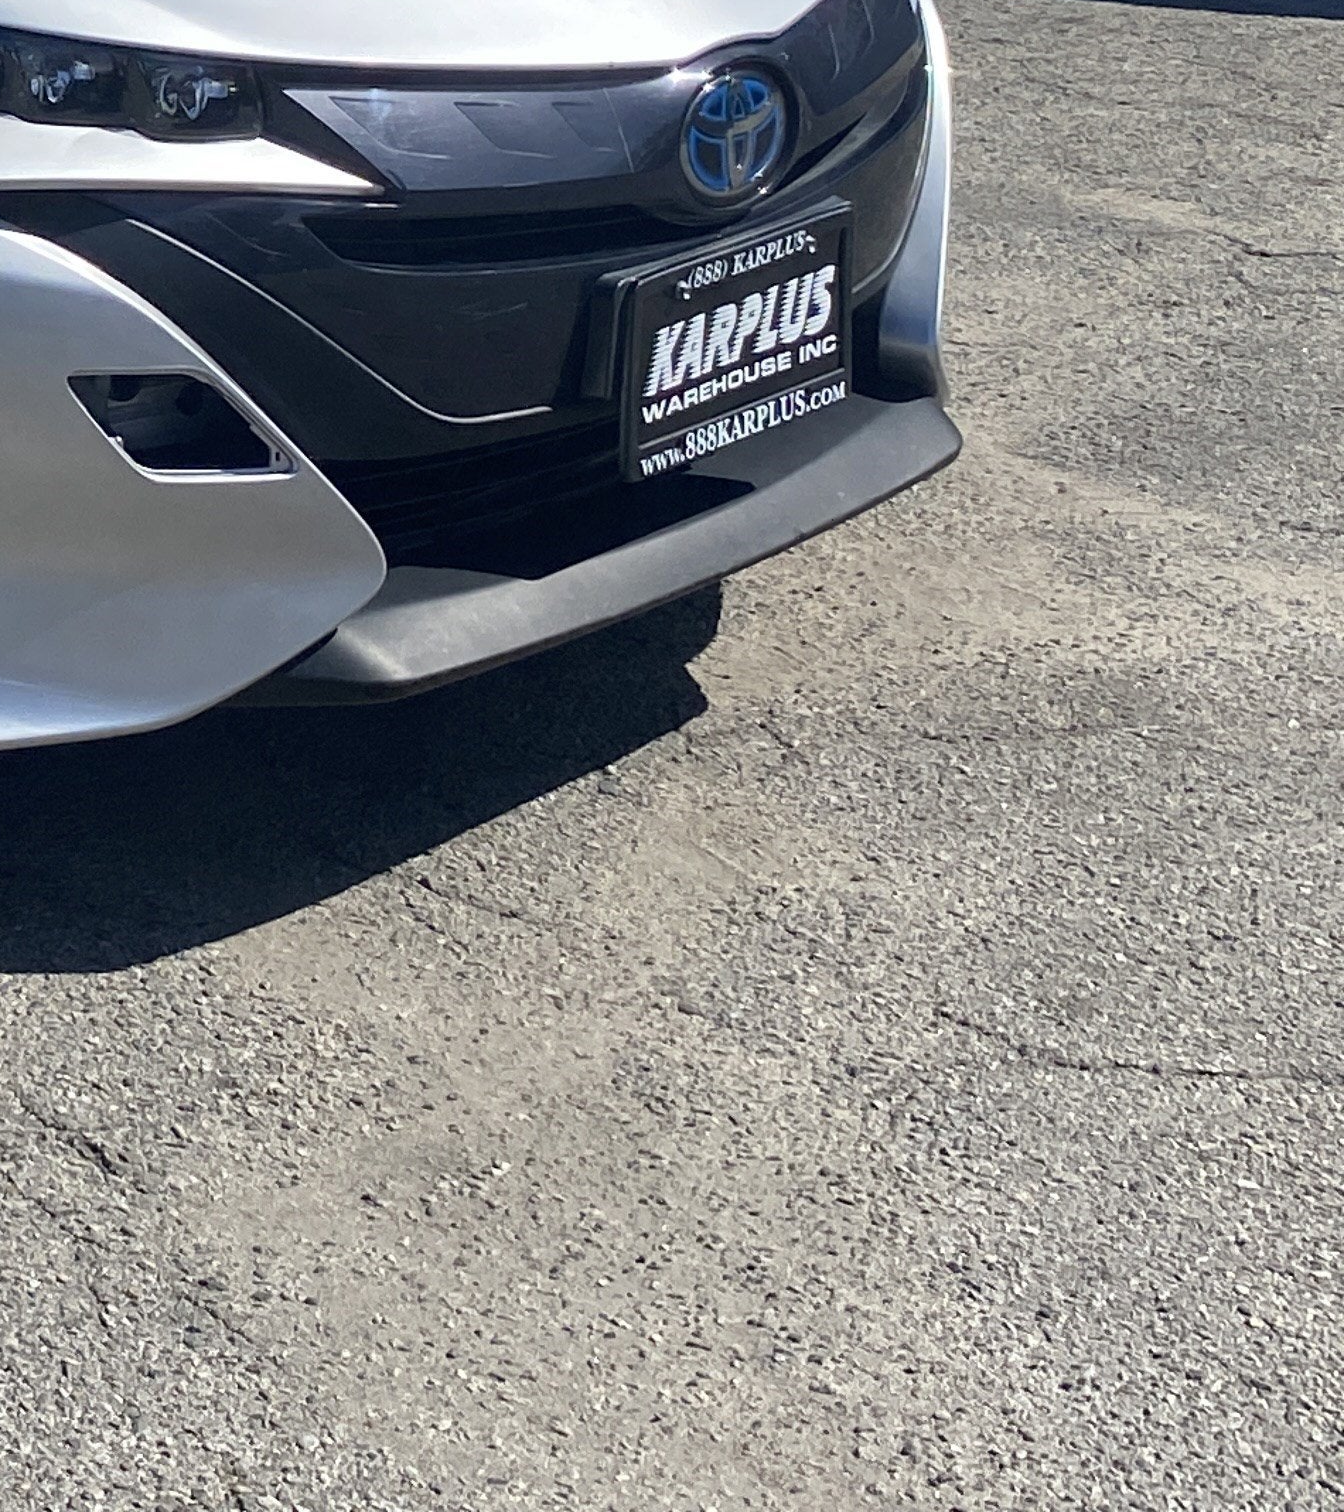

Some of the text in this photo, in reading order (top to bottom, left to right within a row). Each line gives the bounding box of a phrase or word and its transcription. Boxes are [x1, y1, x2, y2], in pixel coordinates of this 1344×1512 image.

[688, 229, 807, 289] (888) KARPLUS
[642, 263, 836, 397] KARPLUS
[641, 334, 838, 424] WAREHOUSE INC
